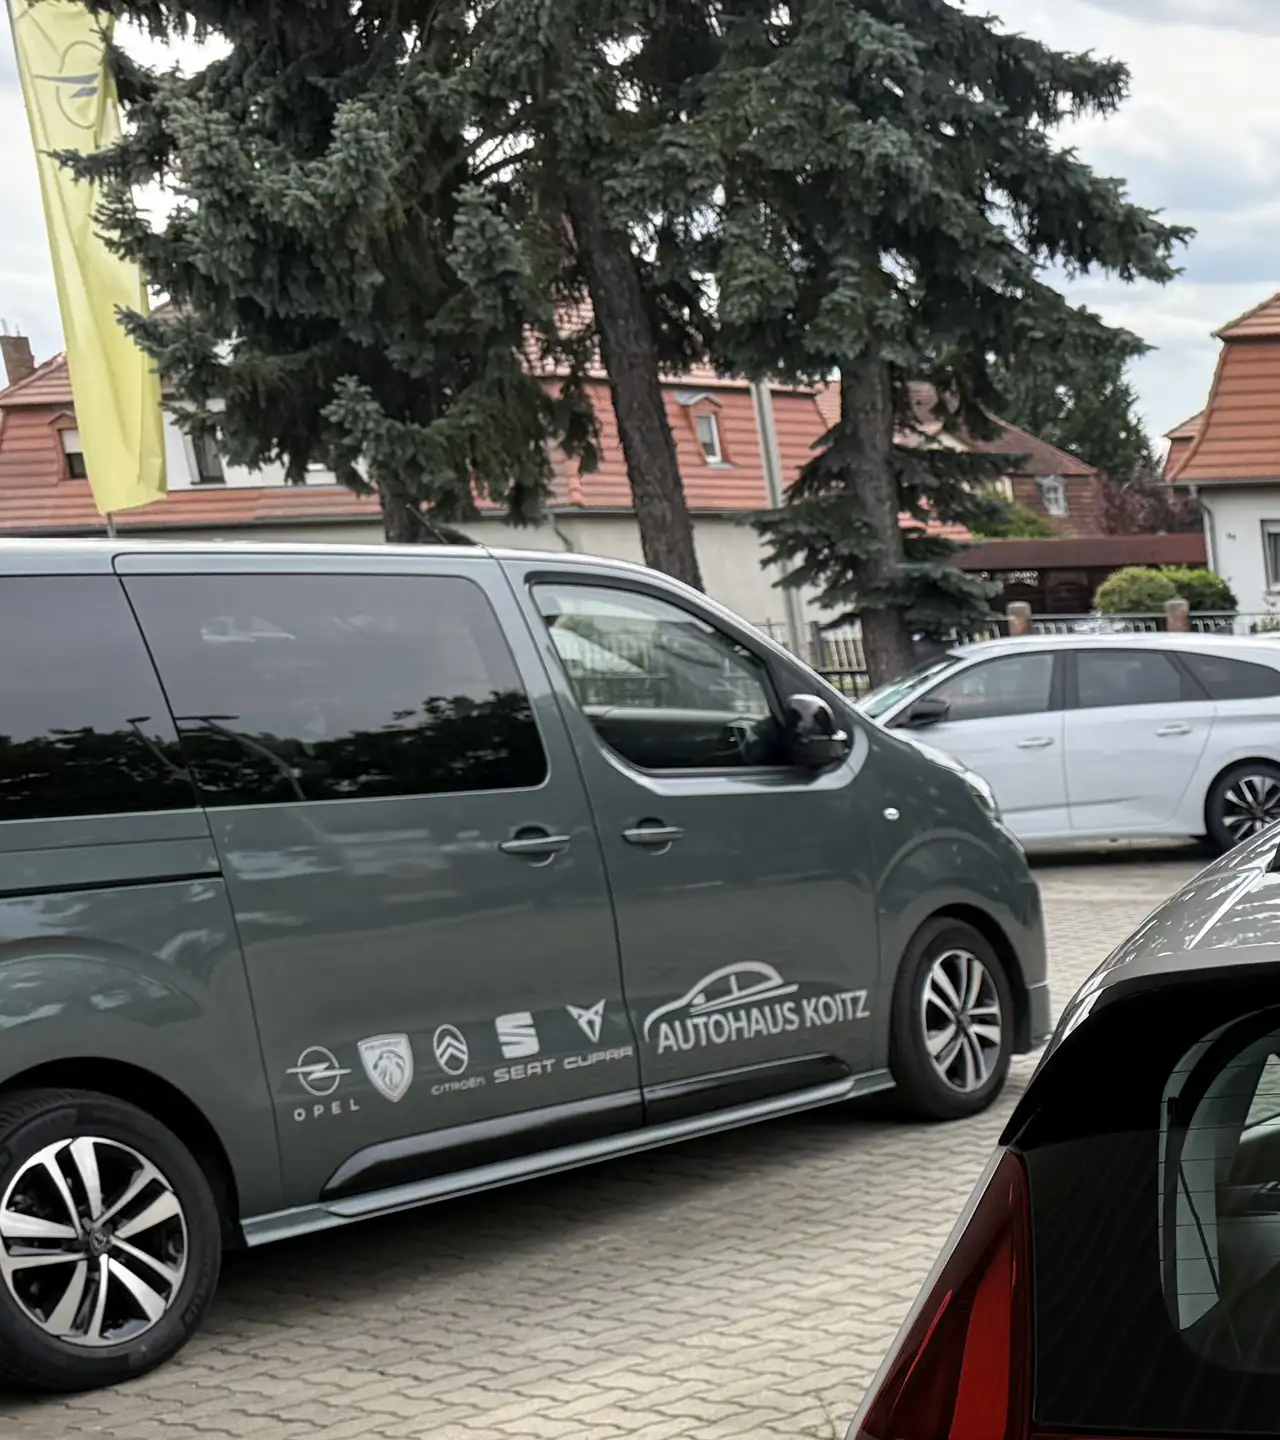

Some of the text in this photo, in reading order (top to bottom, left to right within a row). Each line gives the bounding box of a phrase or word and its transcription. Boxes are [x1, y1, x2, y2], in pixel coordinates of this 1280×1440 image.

[657, 988, 872, 1056] AUTOHAUS KOITZ
[493, 1057, 557, 1084] SEAT
[563, 1045, 635, 1071] CUPRA
[293, 1098, 361, 1122] OPEL
